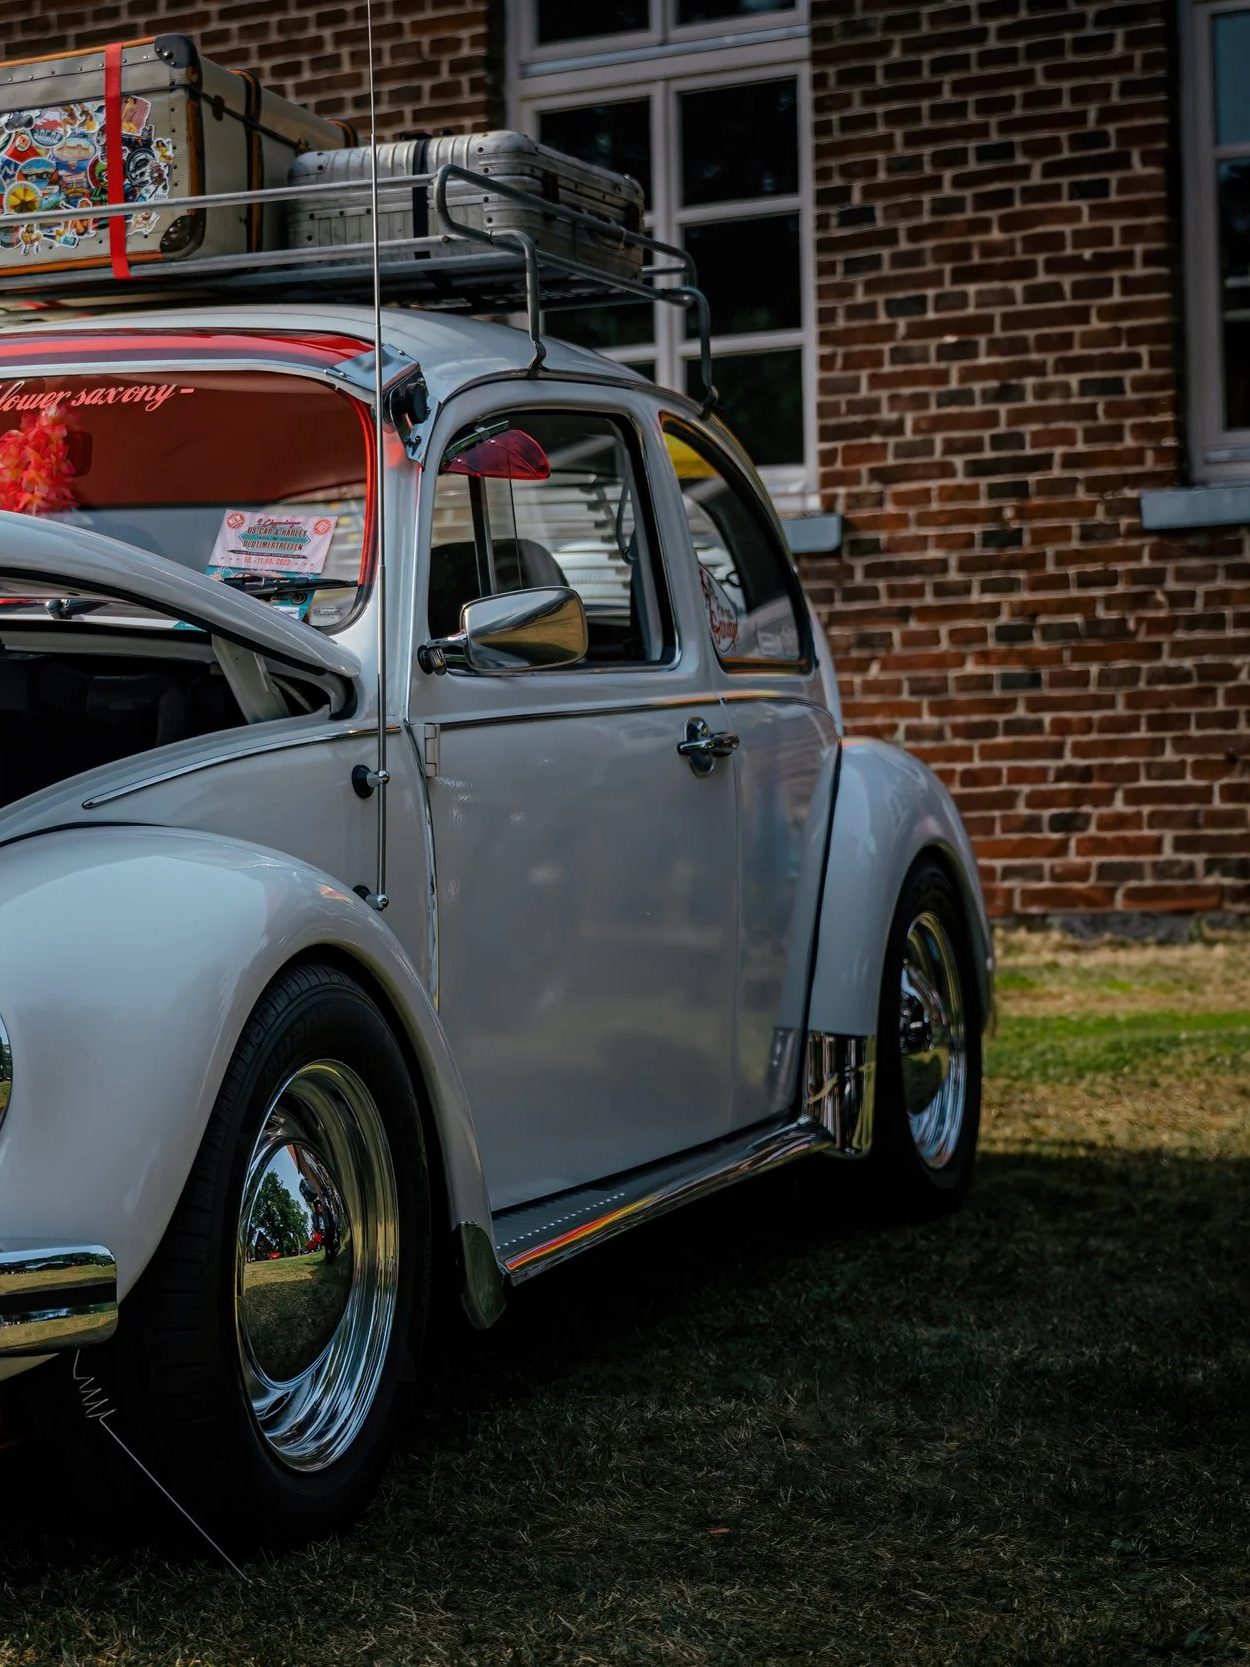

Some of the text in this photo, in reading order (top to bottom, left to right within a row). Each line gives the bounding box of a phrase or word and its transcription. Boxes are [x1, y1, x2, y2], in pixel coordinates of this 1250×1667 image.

[70, 383, 178, 412] saxony
[281, 528, 309, 538] HARLEY
[243, 541, 303, 551] OLDTIMERTREFFEN
